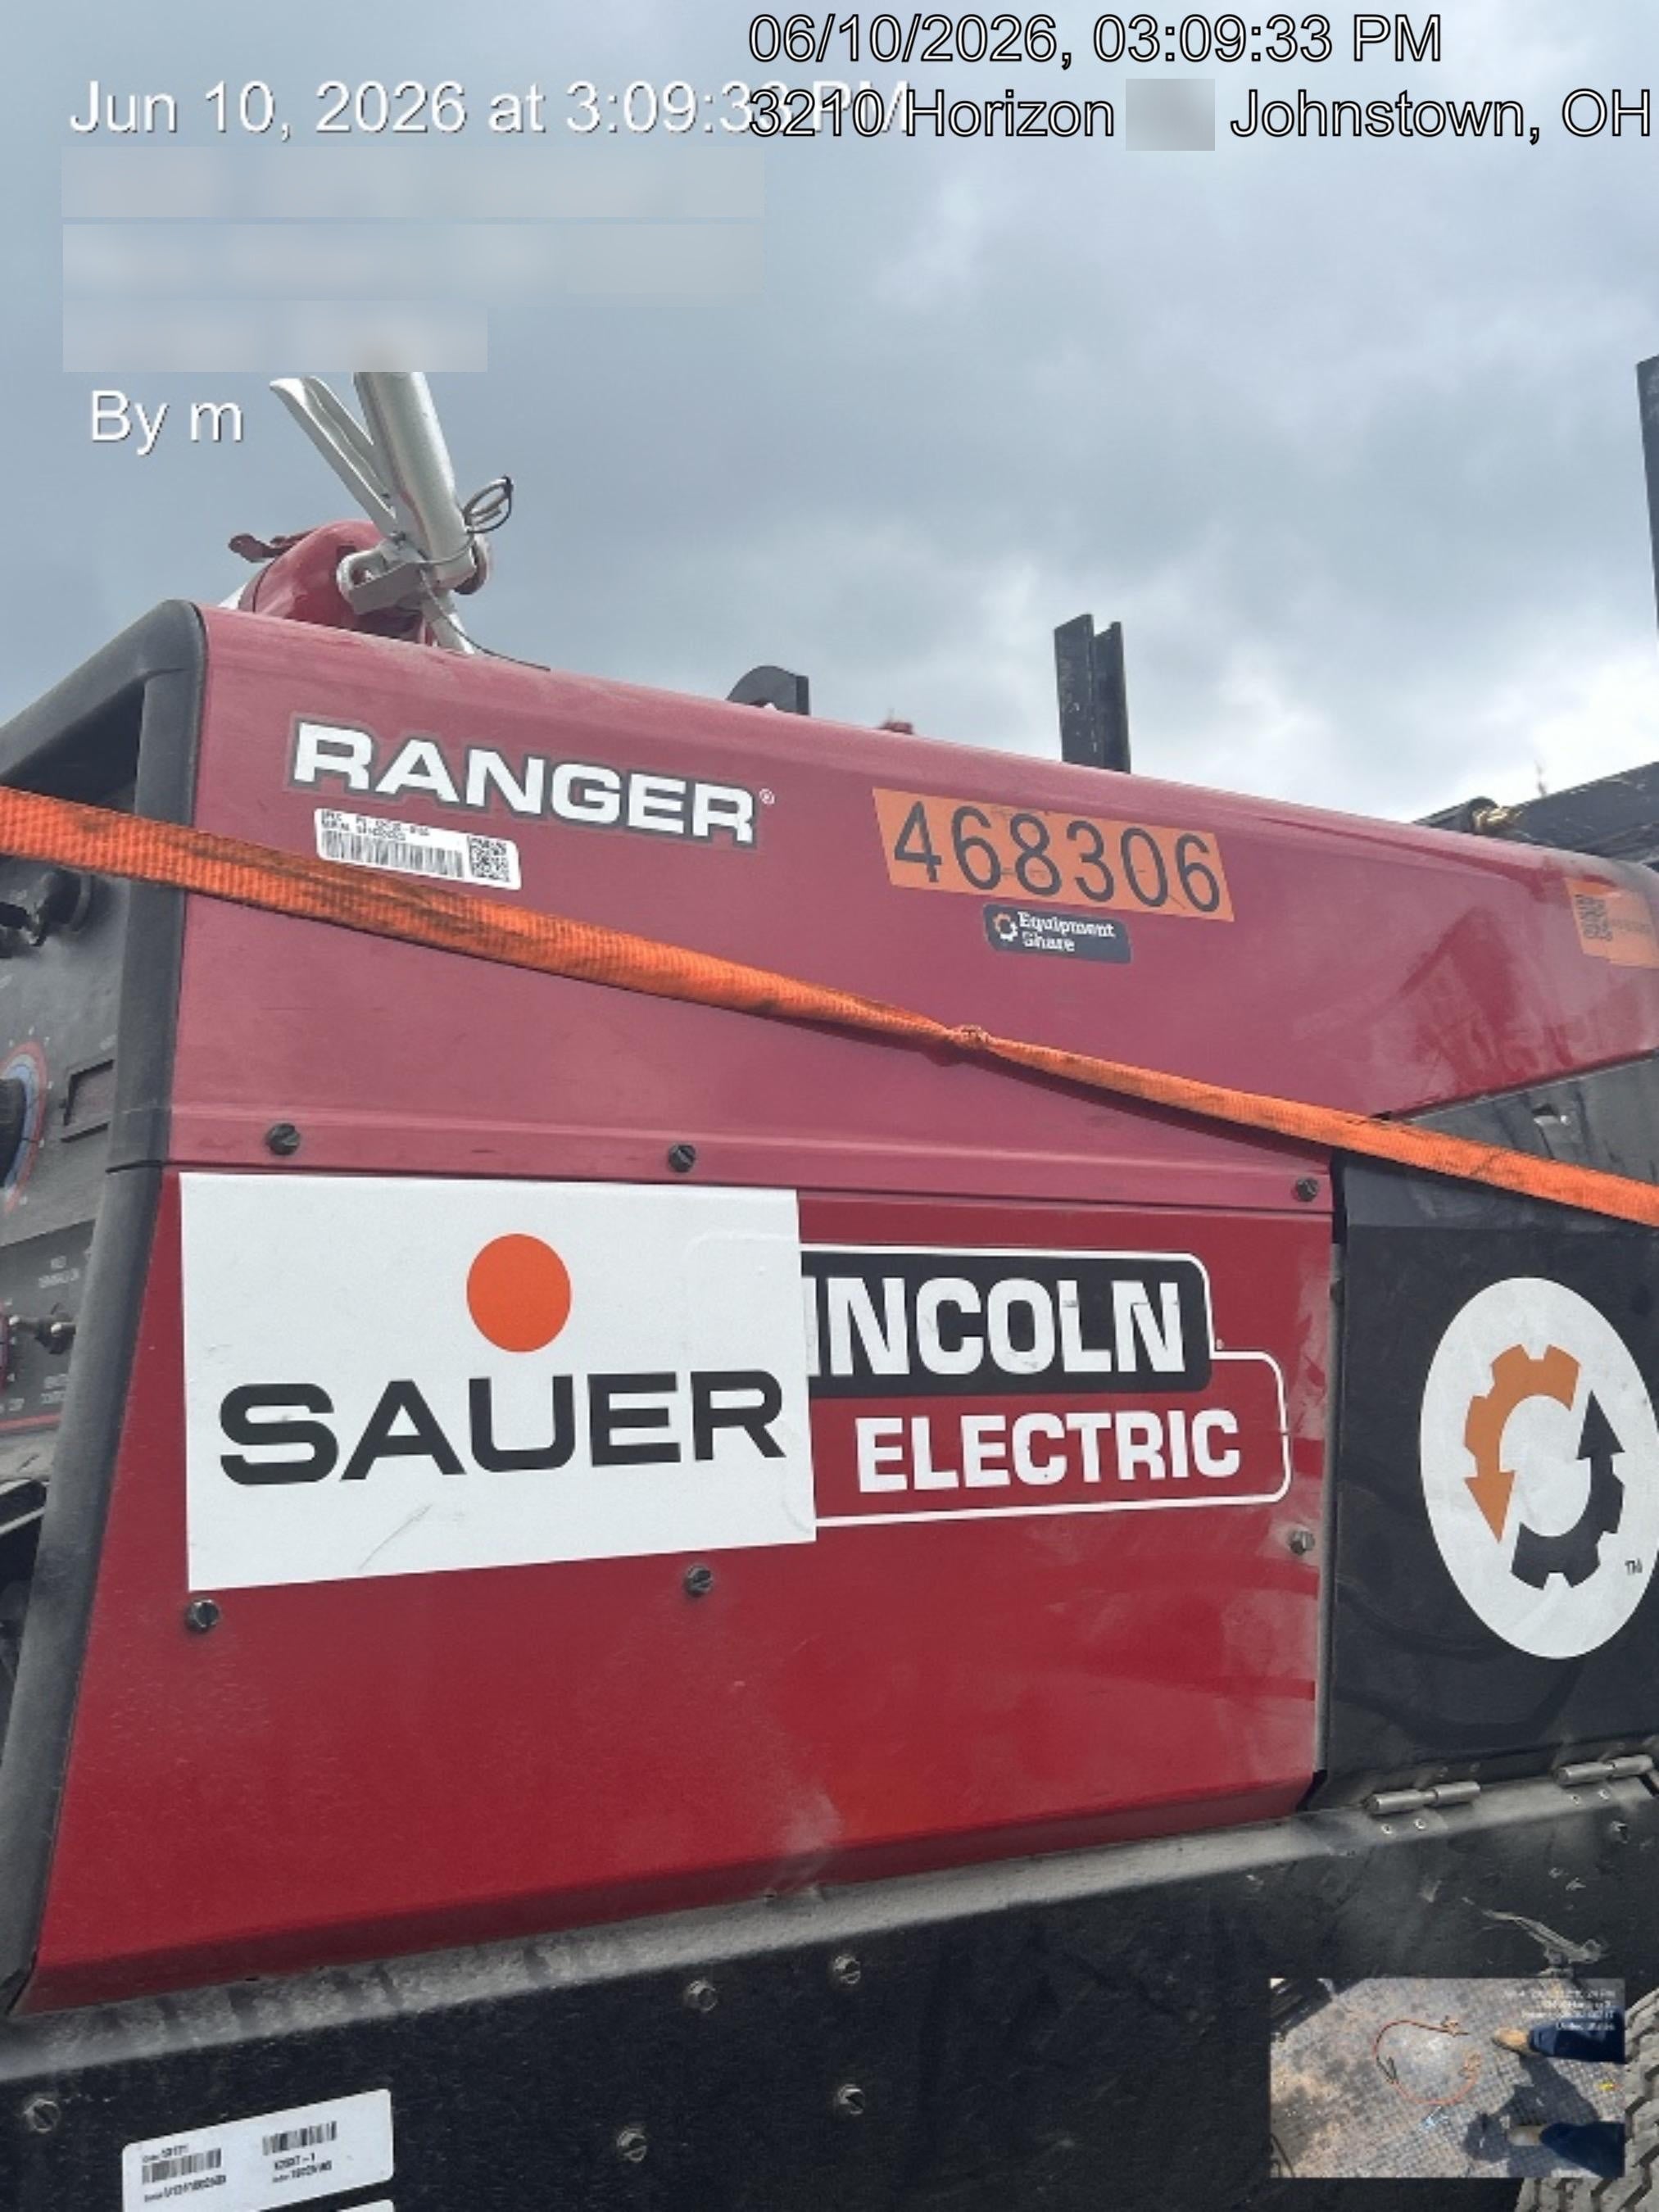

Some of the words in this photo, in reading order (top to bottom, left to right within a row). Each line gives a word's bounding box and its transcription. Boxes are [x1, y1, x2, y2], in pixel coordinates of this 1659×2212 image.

[293, 721, 755, 844] RANGER
[894, 800, 1220, 913] 468306
[1018, 912, 1115, 937] Equipment
[1022, 931, 1075, 952] Share
[800, 1276, 1185, 1378] INCOLN
[219, 1369, 786, 1486] SAUER
[855, 1408, 1240, 1494] ELECTRIC
